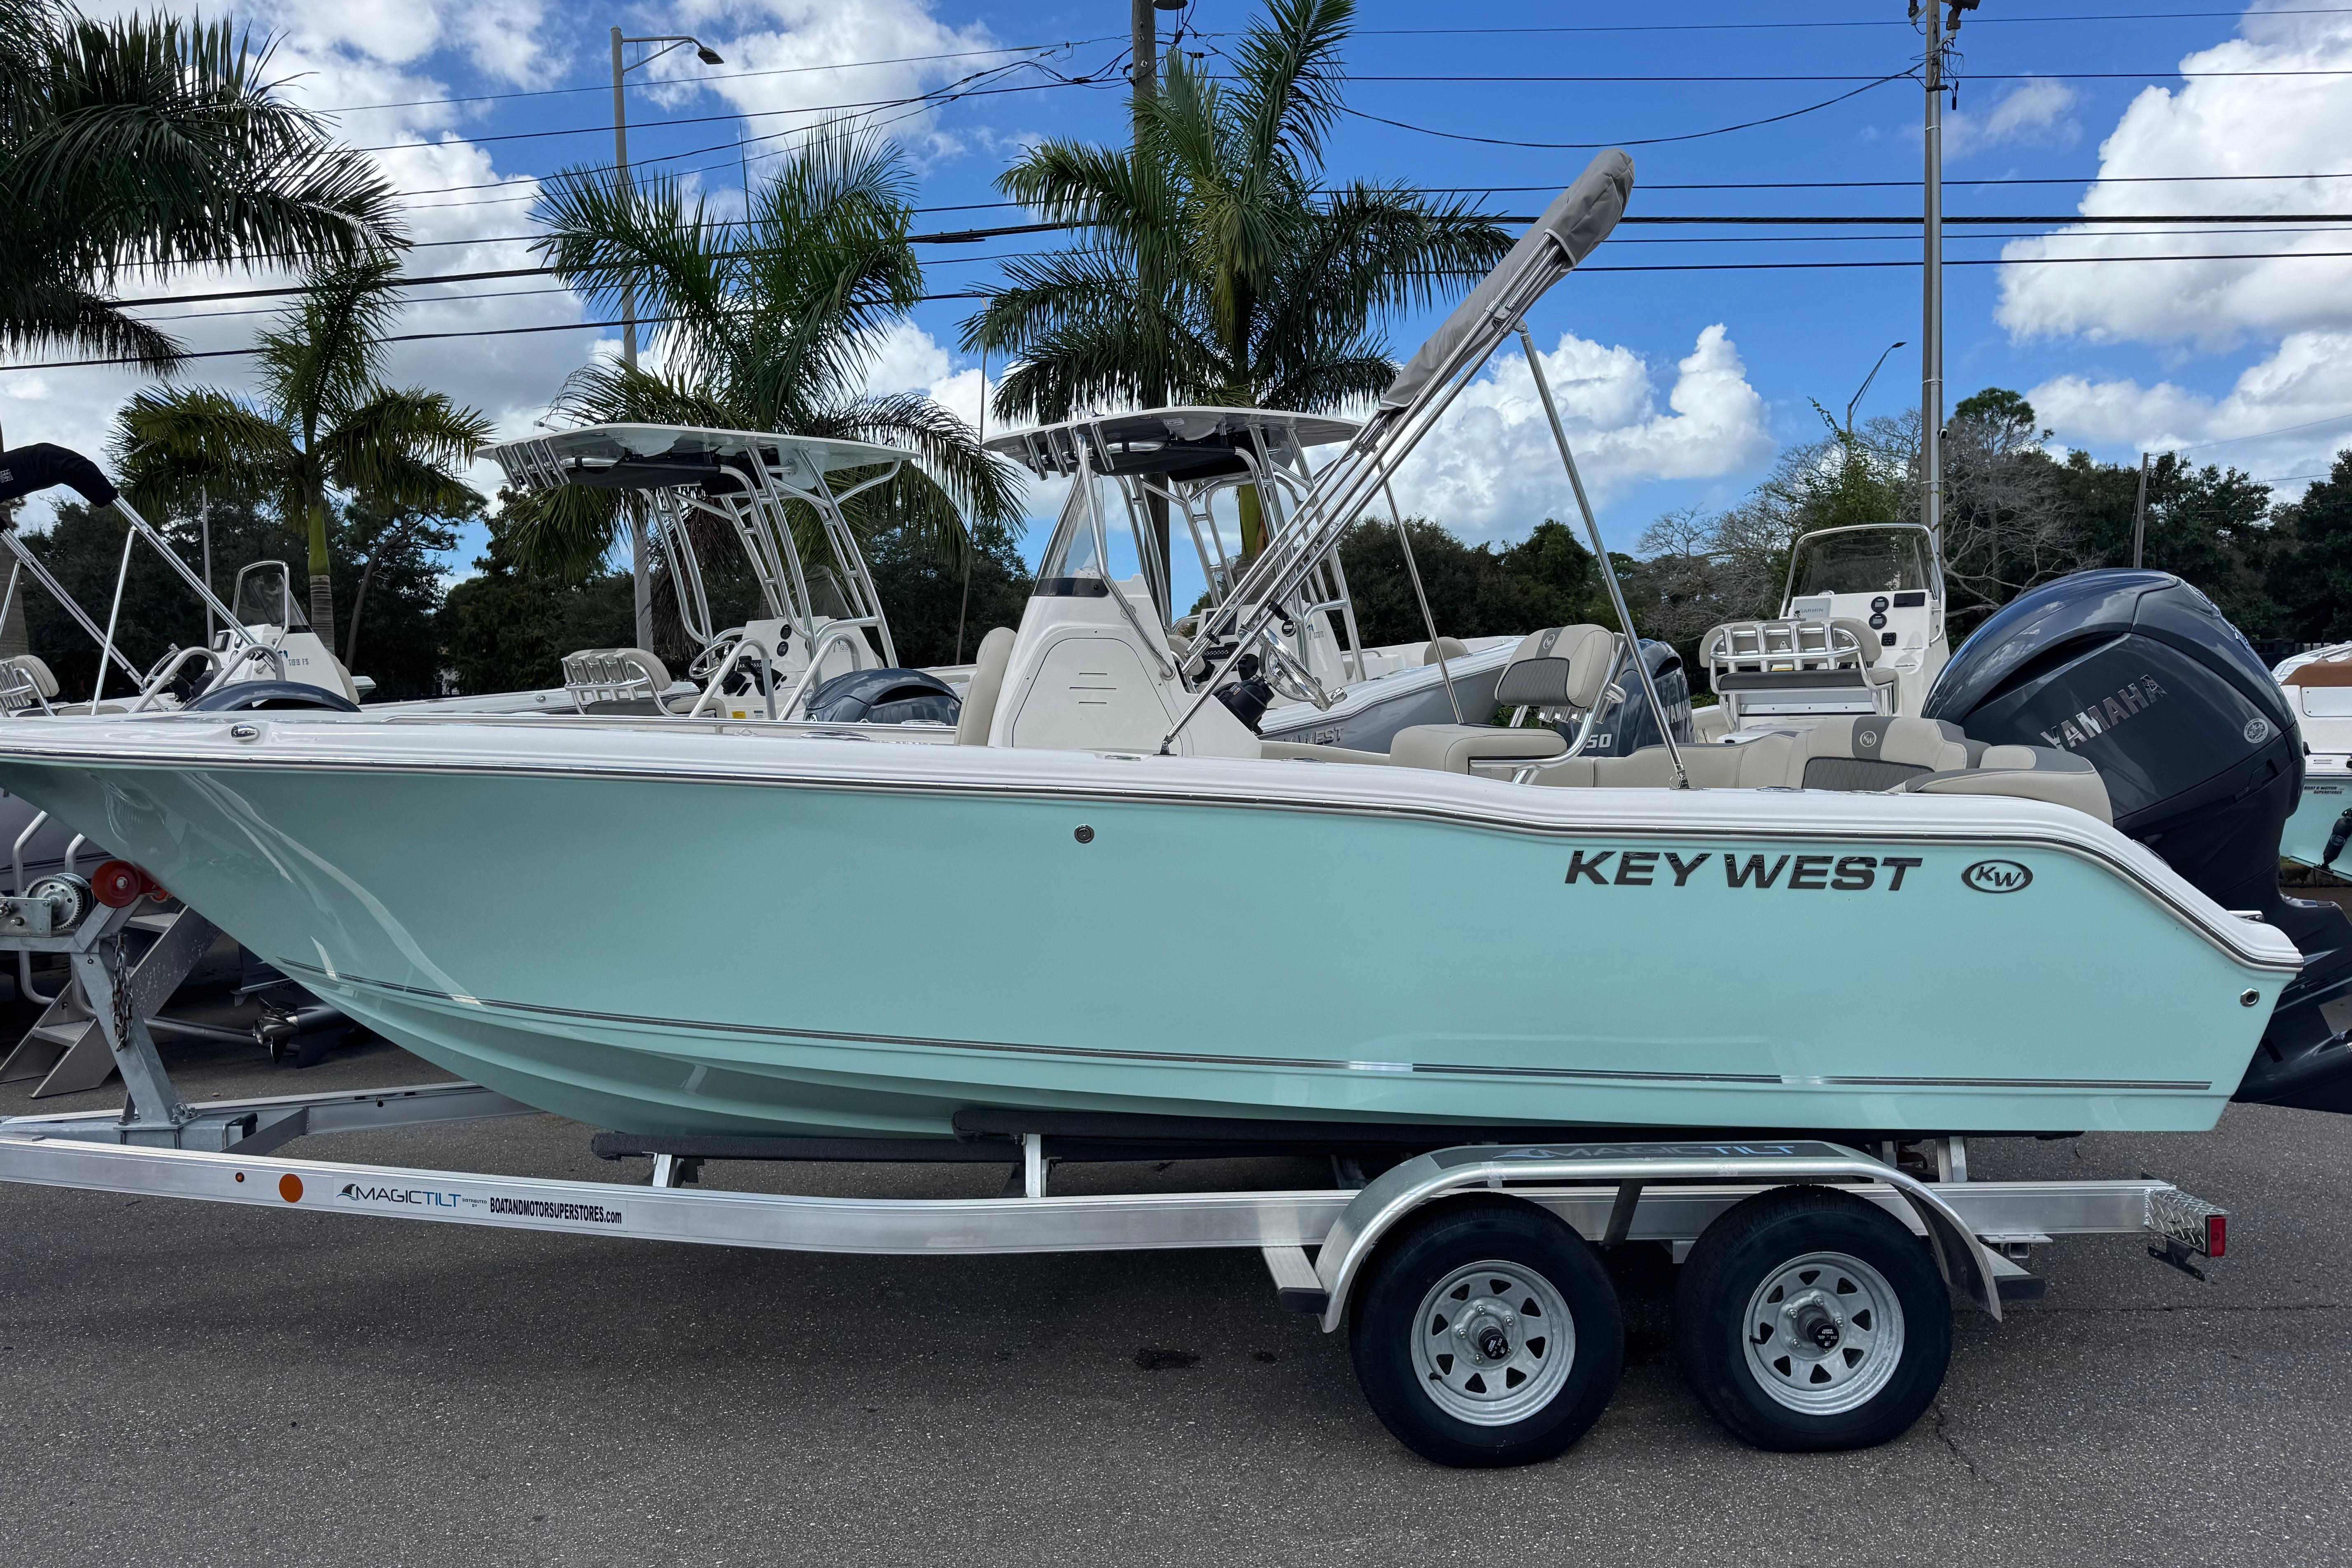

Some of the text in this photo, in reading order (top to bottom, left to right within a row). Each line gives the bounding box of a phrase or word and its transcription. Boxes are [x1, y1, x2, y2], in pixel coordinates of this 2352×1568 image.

[2040, 674, 2168, 751] YAMAHA
[1298, 725, 1344, 744] WEST
[1564, 850, 1923, 891] KEY WEST
[1976, 865, 2022, 887] KW
[1540, 1146, 1795, 1157] MAGICTILT
[355, 1185, 461, 1207] MAGICTILT
[490, 1197, 622, 1224] BOATANDMOTORSUPERSTORES.com
